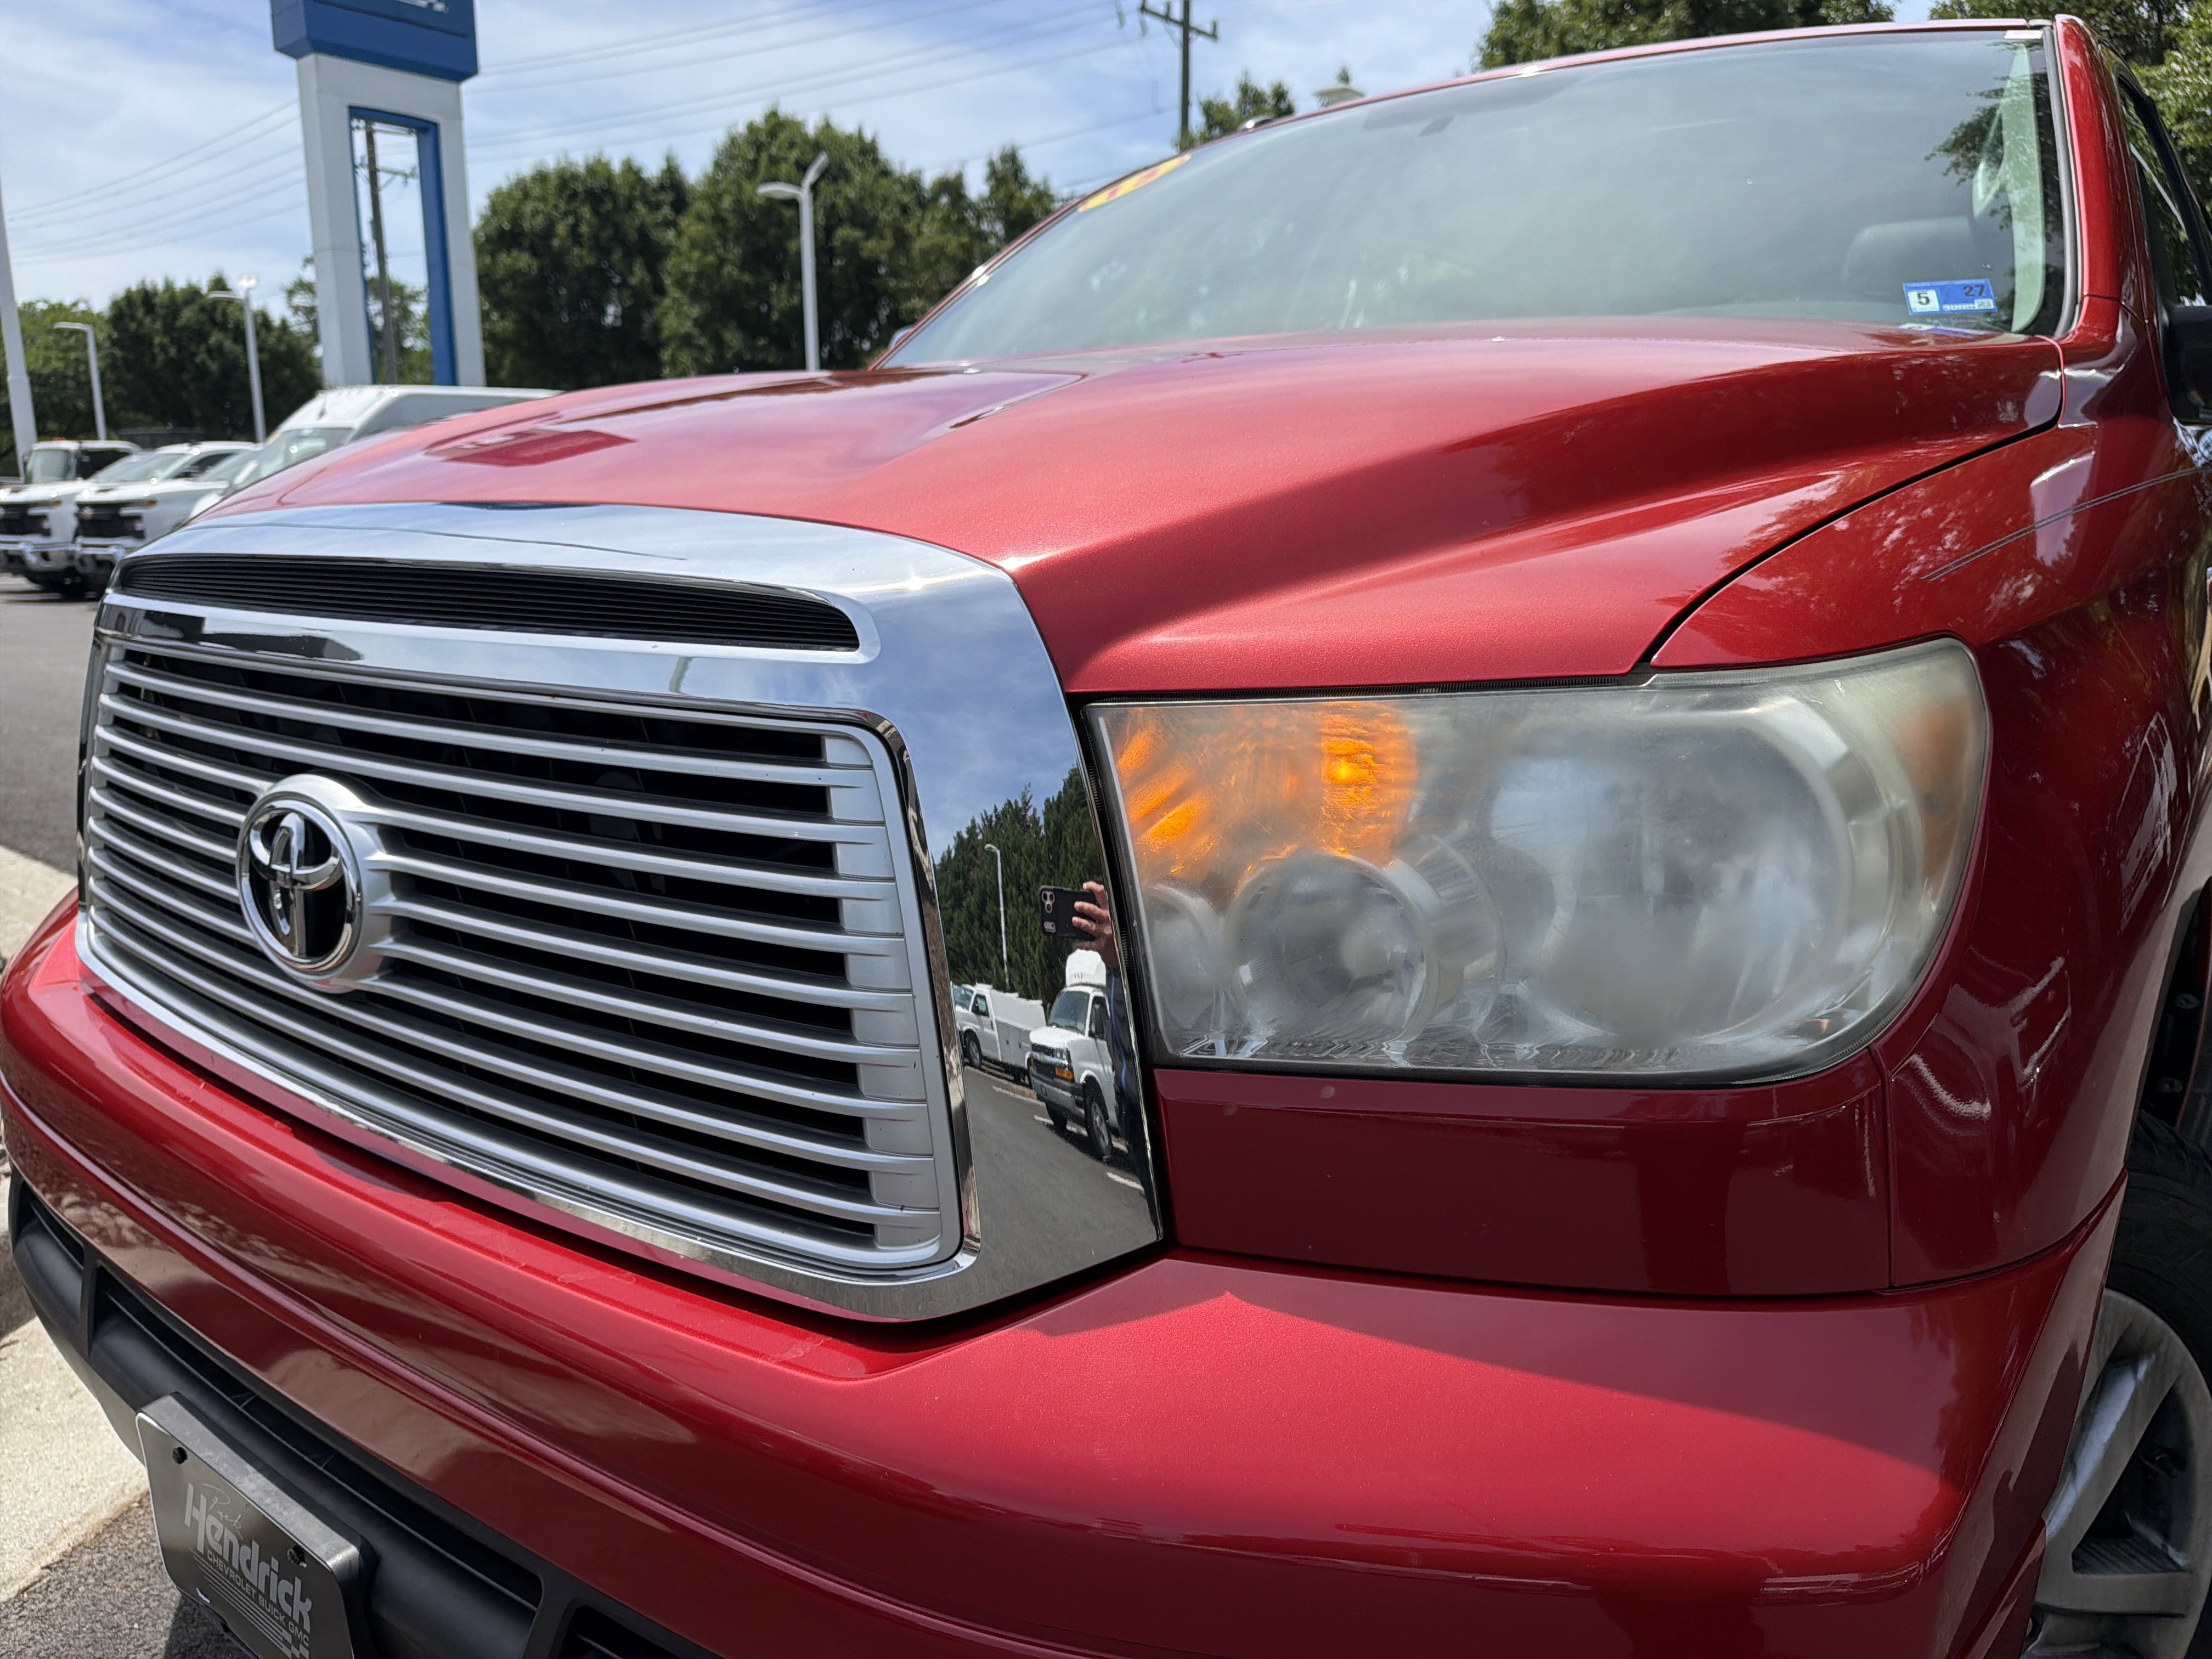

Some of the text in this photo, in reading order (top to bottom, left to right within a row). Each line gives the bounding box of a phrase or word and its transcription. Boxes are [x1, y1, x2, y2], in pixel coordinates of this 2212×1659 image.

[1917, 292, 1930, 306] 5
[1963, 285, 1985, 297] 27
[184, 1482, 312, 1634] Hendrick
[207, 1550, 309, 1647] CHEVROLET BUICK GMC
